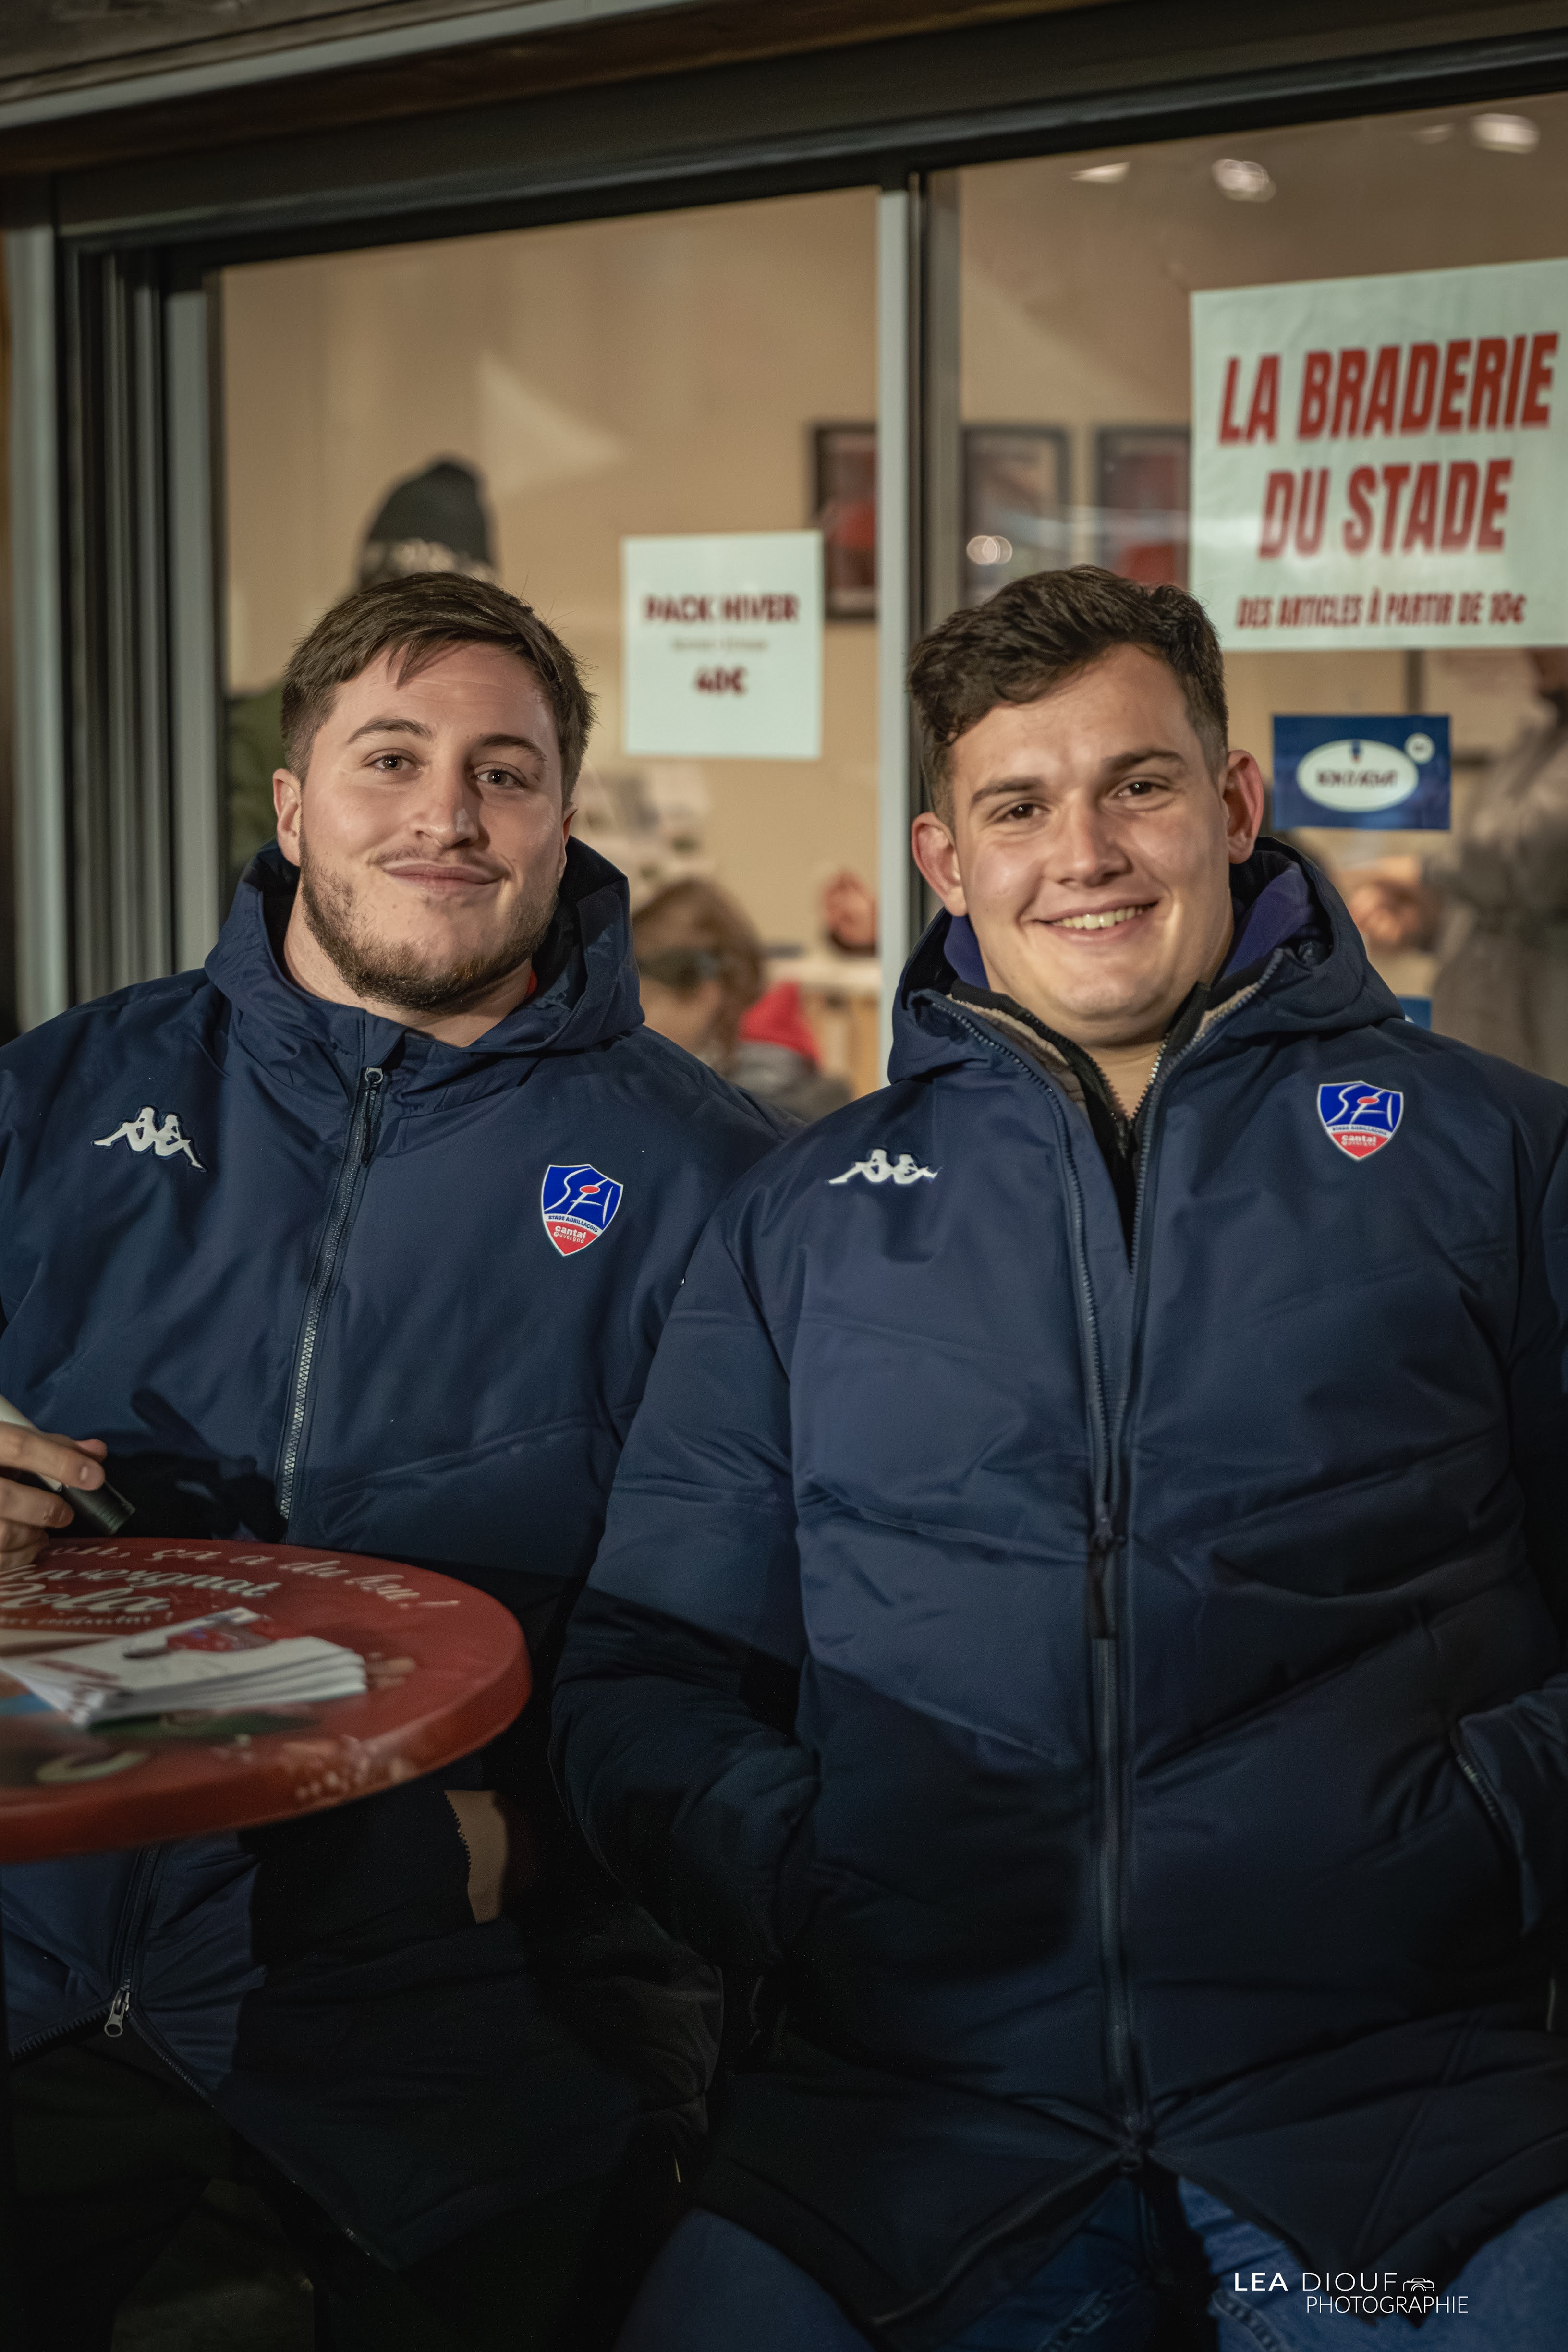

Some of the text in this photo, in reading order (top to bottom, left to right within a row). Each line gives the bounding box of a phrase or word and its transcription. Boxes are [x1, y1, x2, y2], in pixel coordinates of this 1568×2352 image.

[1218, 332, 1560, 446] LA BRADERIE
[1257, 459, 1514, 561] DU STADE
[645, 593, 800, 622] PACK HIVER
[1237, 586, 1527, 629] DES ARTICLES À PARTIR DE 10€
[555, 1225, 586, 1239] cantal
[566, 1217, 598, 1233] AURILLACOIS
